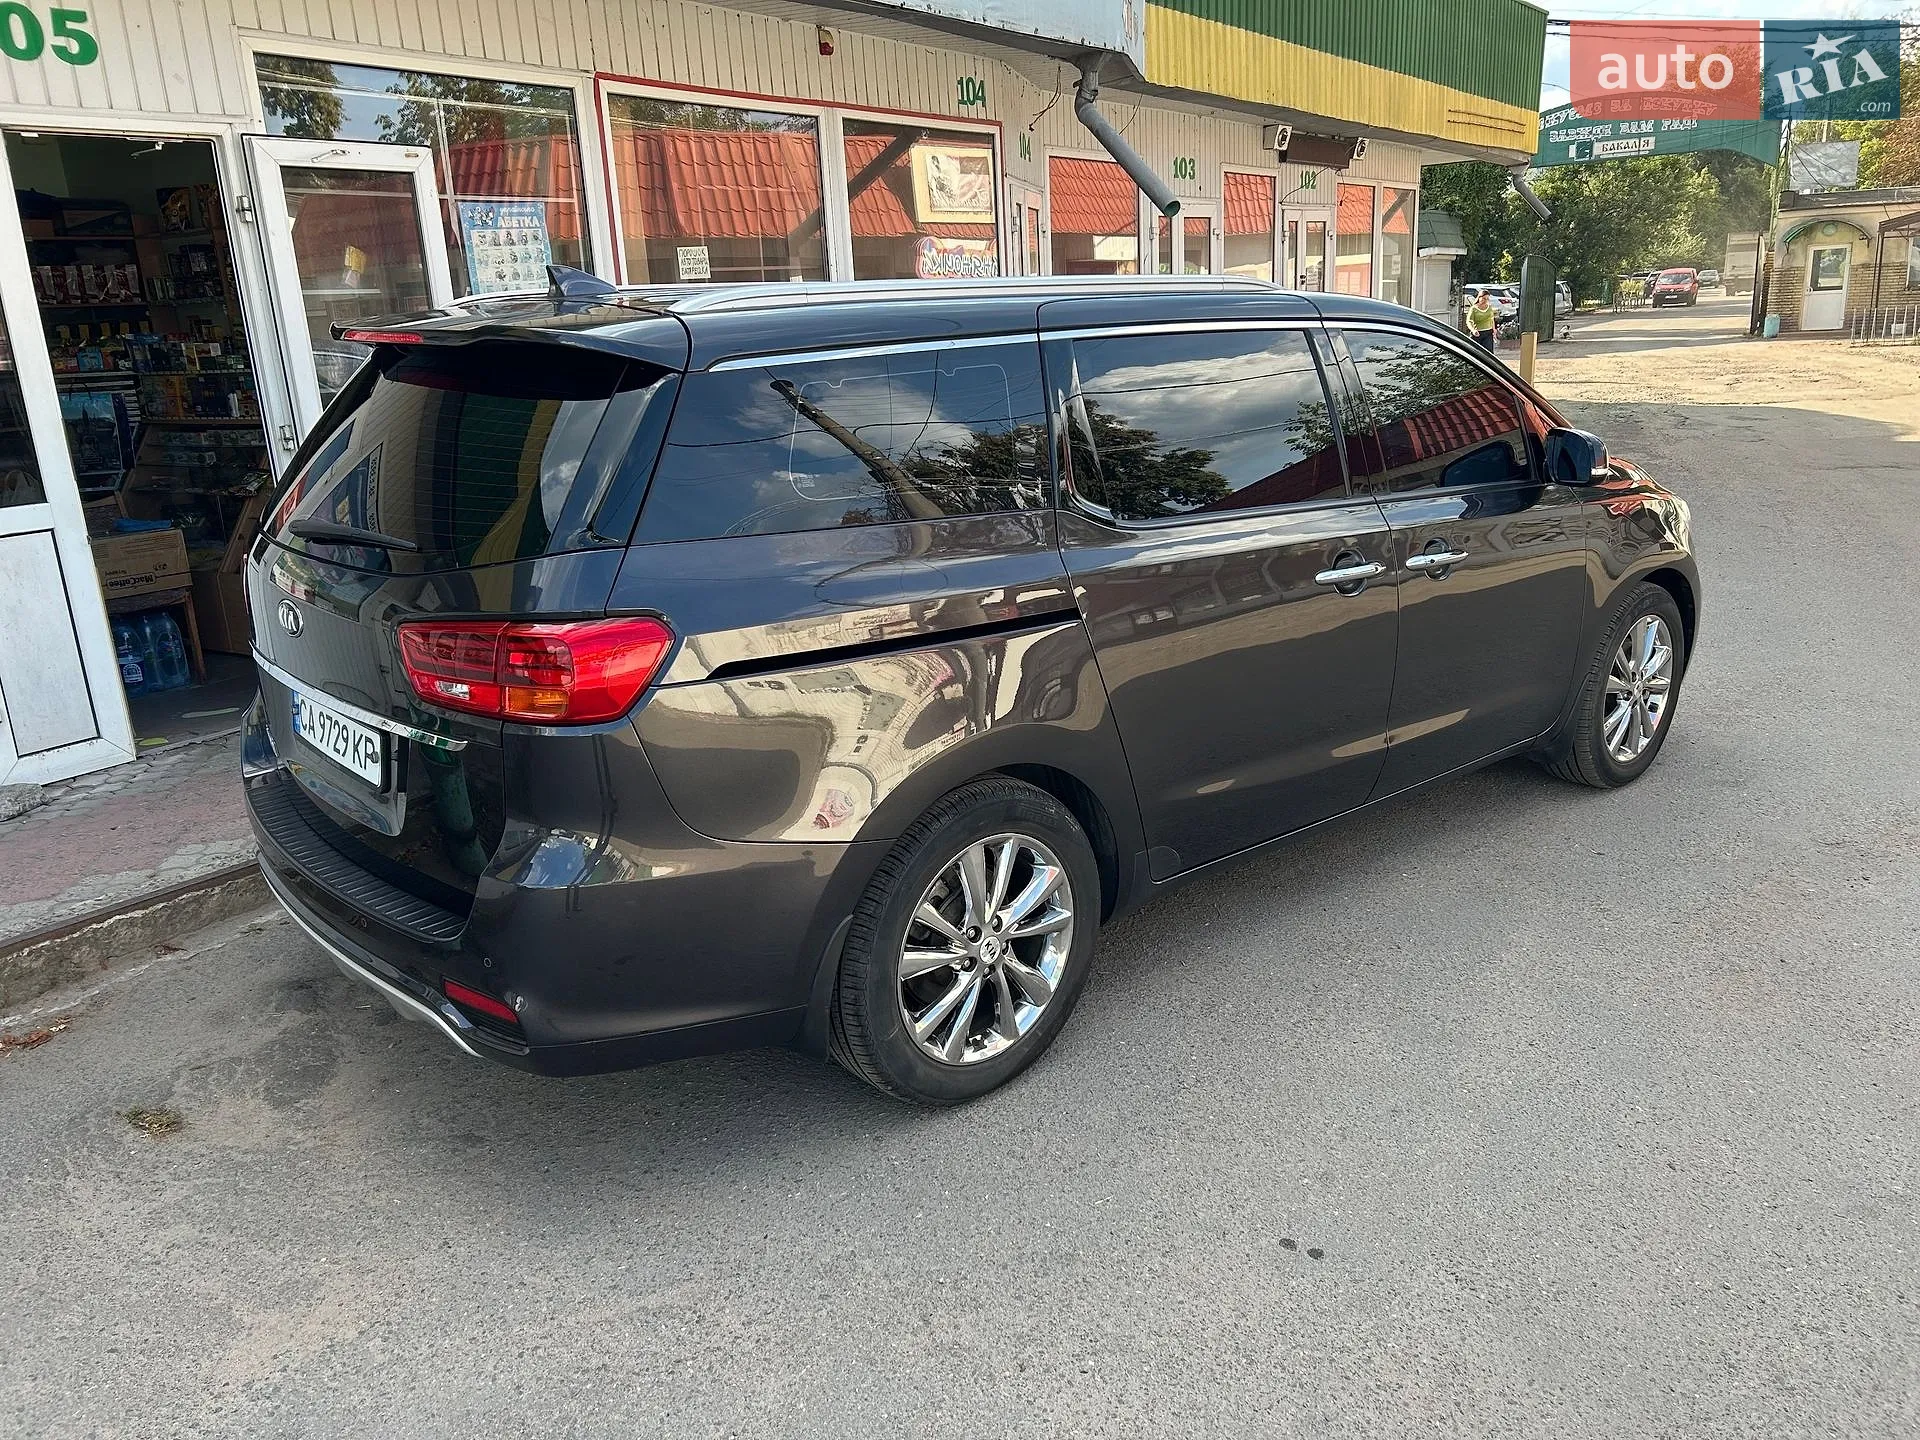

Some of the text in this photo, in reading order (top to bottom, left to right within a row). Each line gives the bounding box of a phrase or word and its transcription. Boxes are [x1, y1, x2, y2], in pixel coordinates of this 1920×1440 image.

[0, 1, 98, 65] 05
[957, 76, 986, 108] 104
[1549, 124, 1612, 143] ЗАВЖДИ
[1620, 119, 1654, 135] ВАМ
[1019, 131, 1032, 162] 104
[1602, 139, 1650, 152] БАКАЛІЯ
[1173, 157, 1196, 180] 103
[1300, 170, 1317, 190] 102
[497, 216, 540, 228] АБЕТКА
[108, 574, 154, 588] MacCoffee
[279, 604, 297, 632] KIA
[299, 700, 316, 740] CA
[318, 711, 349, 758] 9729
[984, 940, 997, 959] KIA
